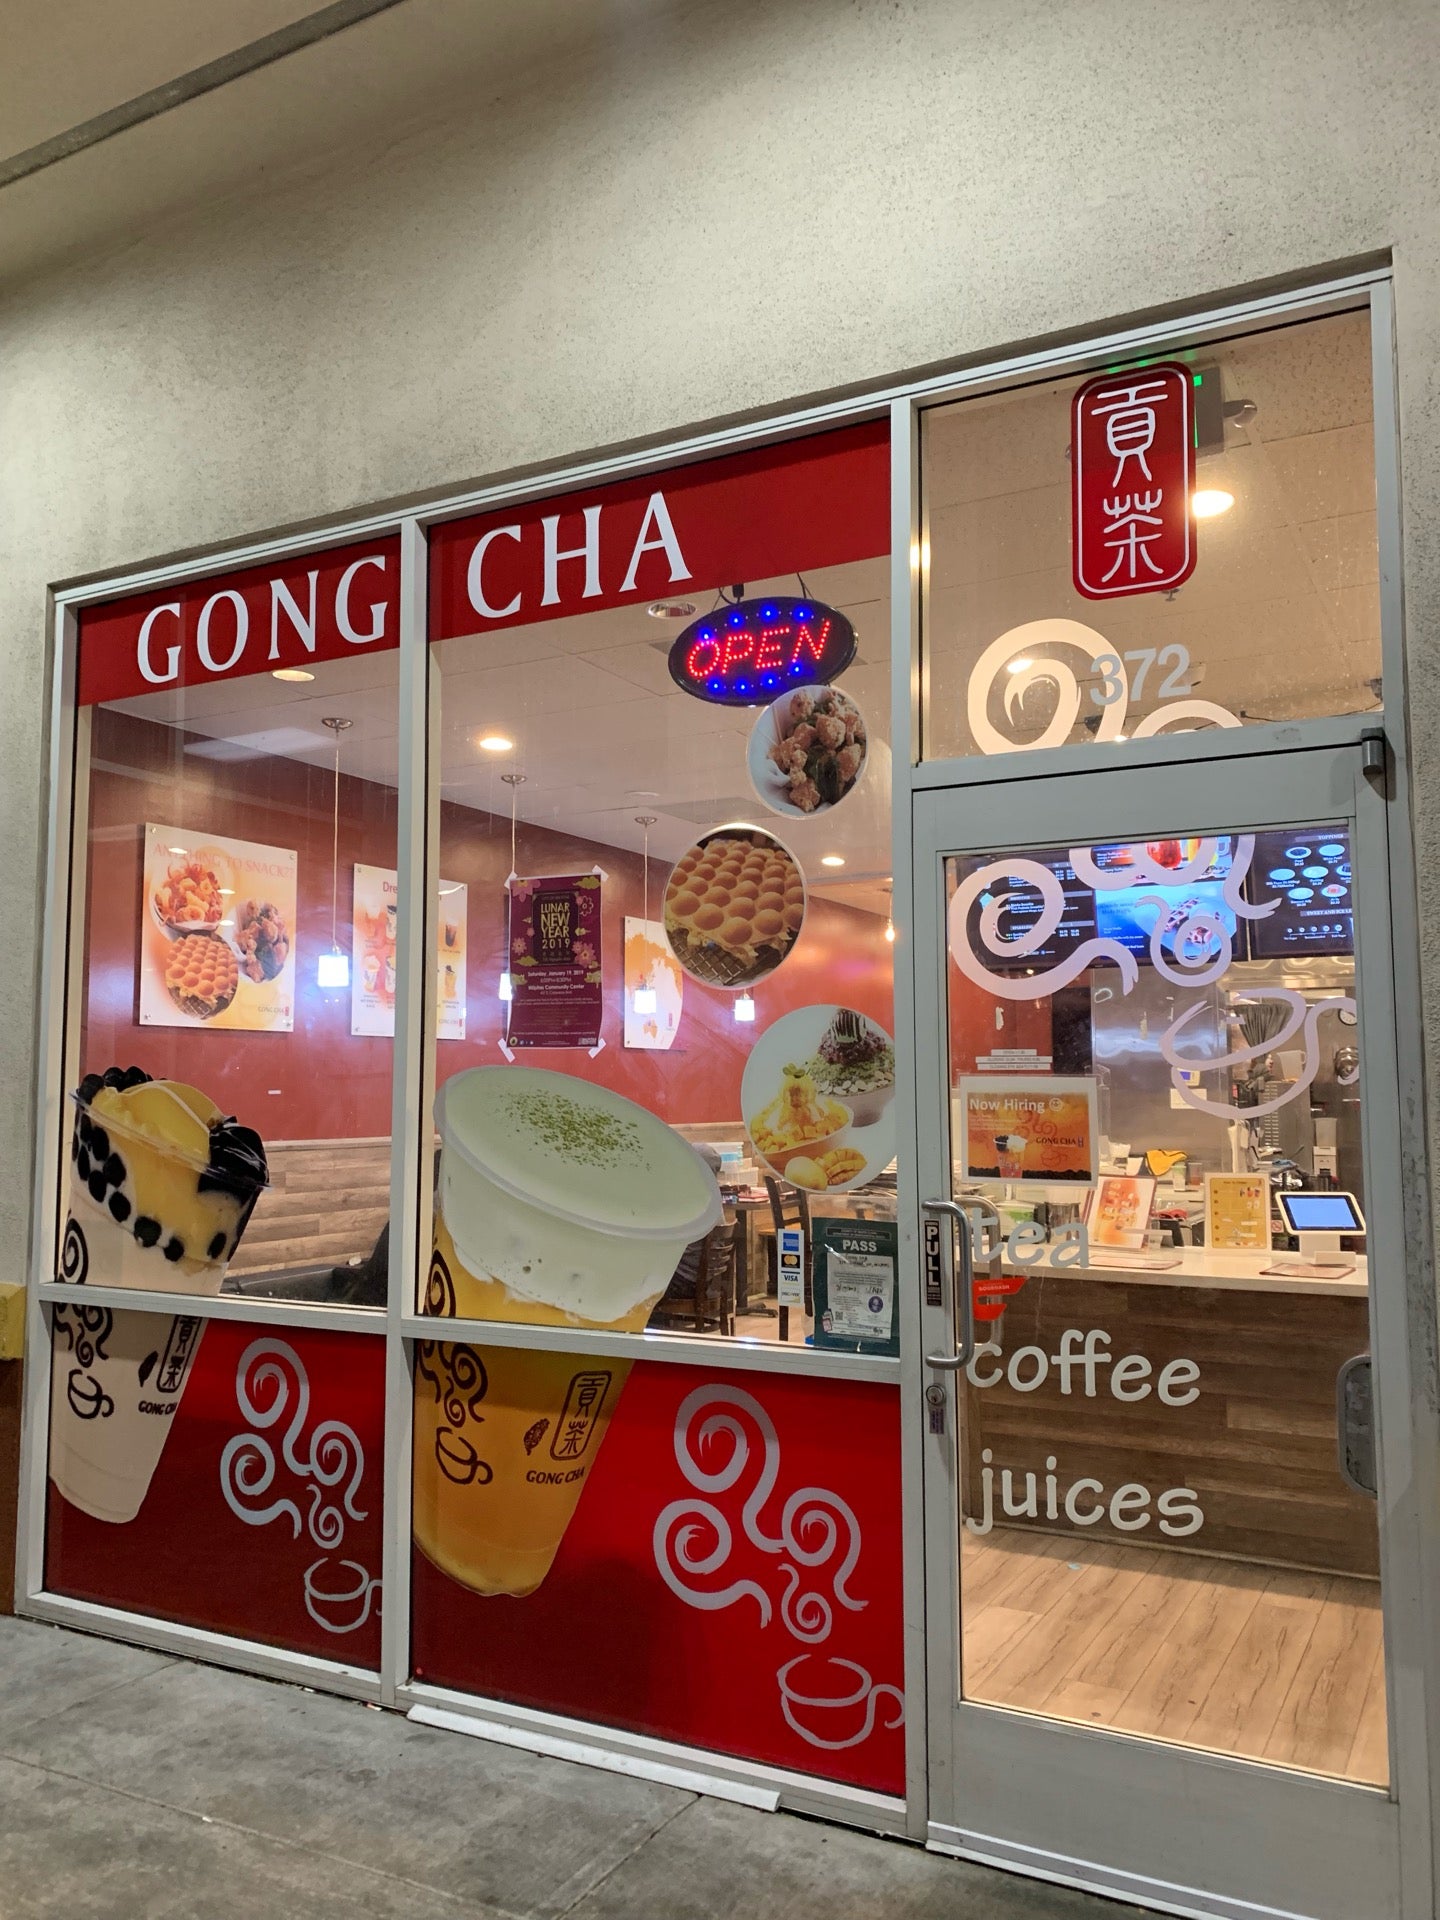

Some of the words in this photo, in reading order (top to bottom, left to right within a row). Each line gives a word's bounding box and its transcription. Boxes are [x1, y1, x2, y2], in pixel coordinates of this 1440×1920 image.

[1091, 380, 1168, 582] 貢茶
[138, 555, 387, 684] GONG
[467, 491, 692, 618] CHA
[686, 618, 831, 678] OPEN
[1089, 643, 1191, 706] 372
[540, 902, 570, 913] LUNAR
[540, 912, 570, 927] NEW
[541, 925, 570, 938] YEAR
[542, 938, 571, 949] 2019
[969, 1099, 1000, 1111] Now
[1004, 1098, 1045, 1113] Hiring
[1035, 1136, 1059, 1145] GONG
[1058, 1137, 1077, 1145] CHA
[842, 1239, 877, 1253] PASS
[972, 1207, 1090, 1268] tea
[926, 1226, 939, 1286] PULL
[966, 1329, 1201, 1407] coffee
[138, 1400, 165, 1416] GONG
[525, 1469, 564, 1485] GONG
[565, 1465, 586, 1483] CHA
[965, 1448, 1205, 1537] juices
